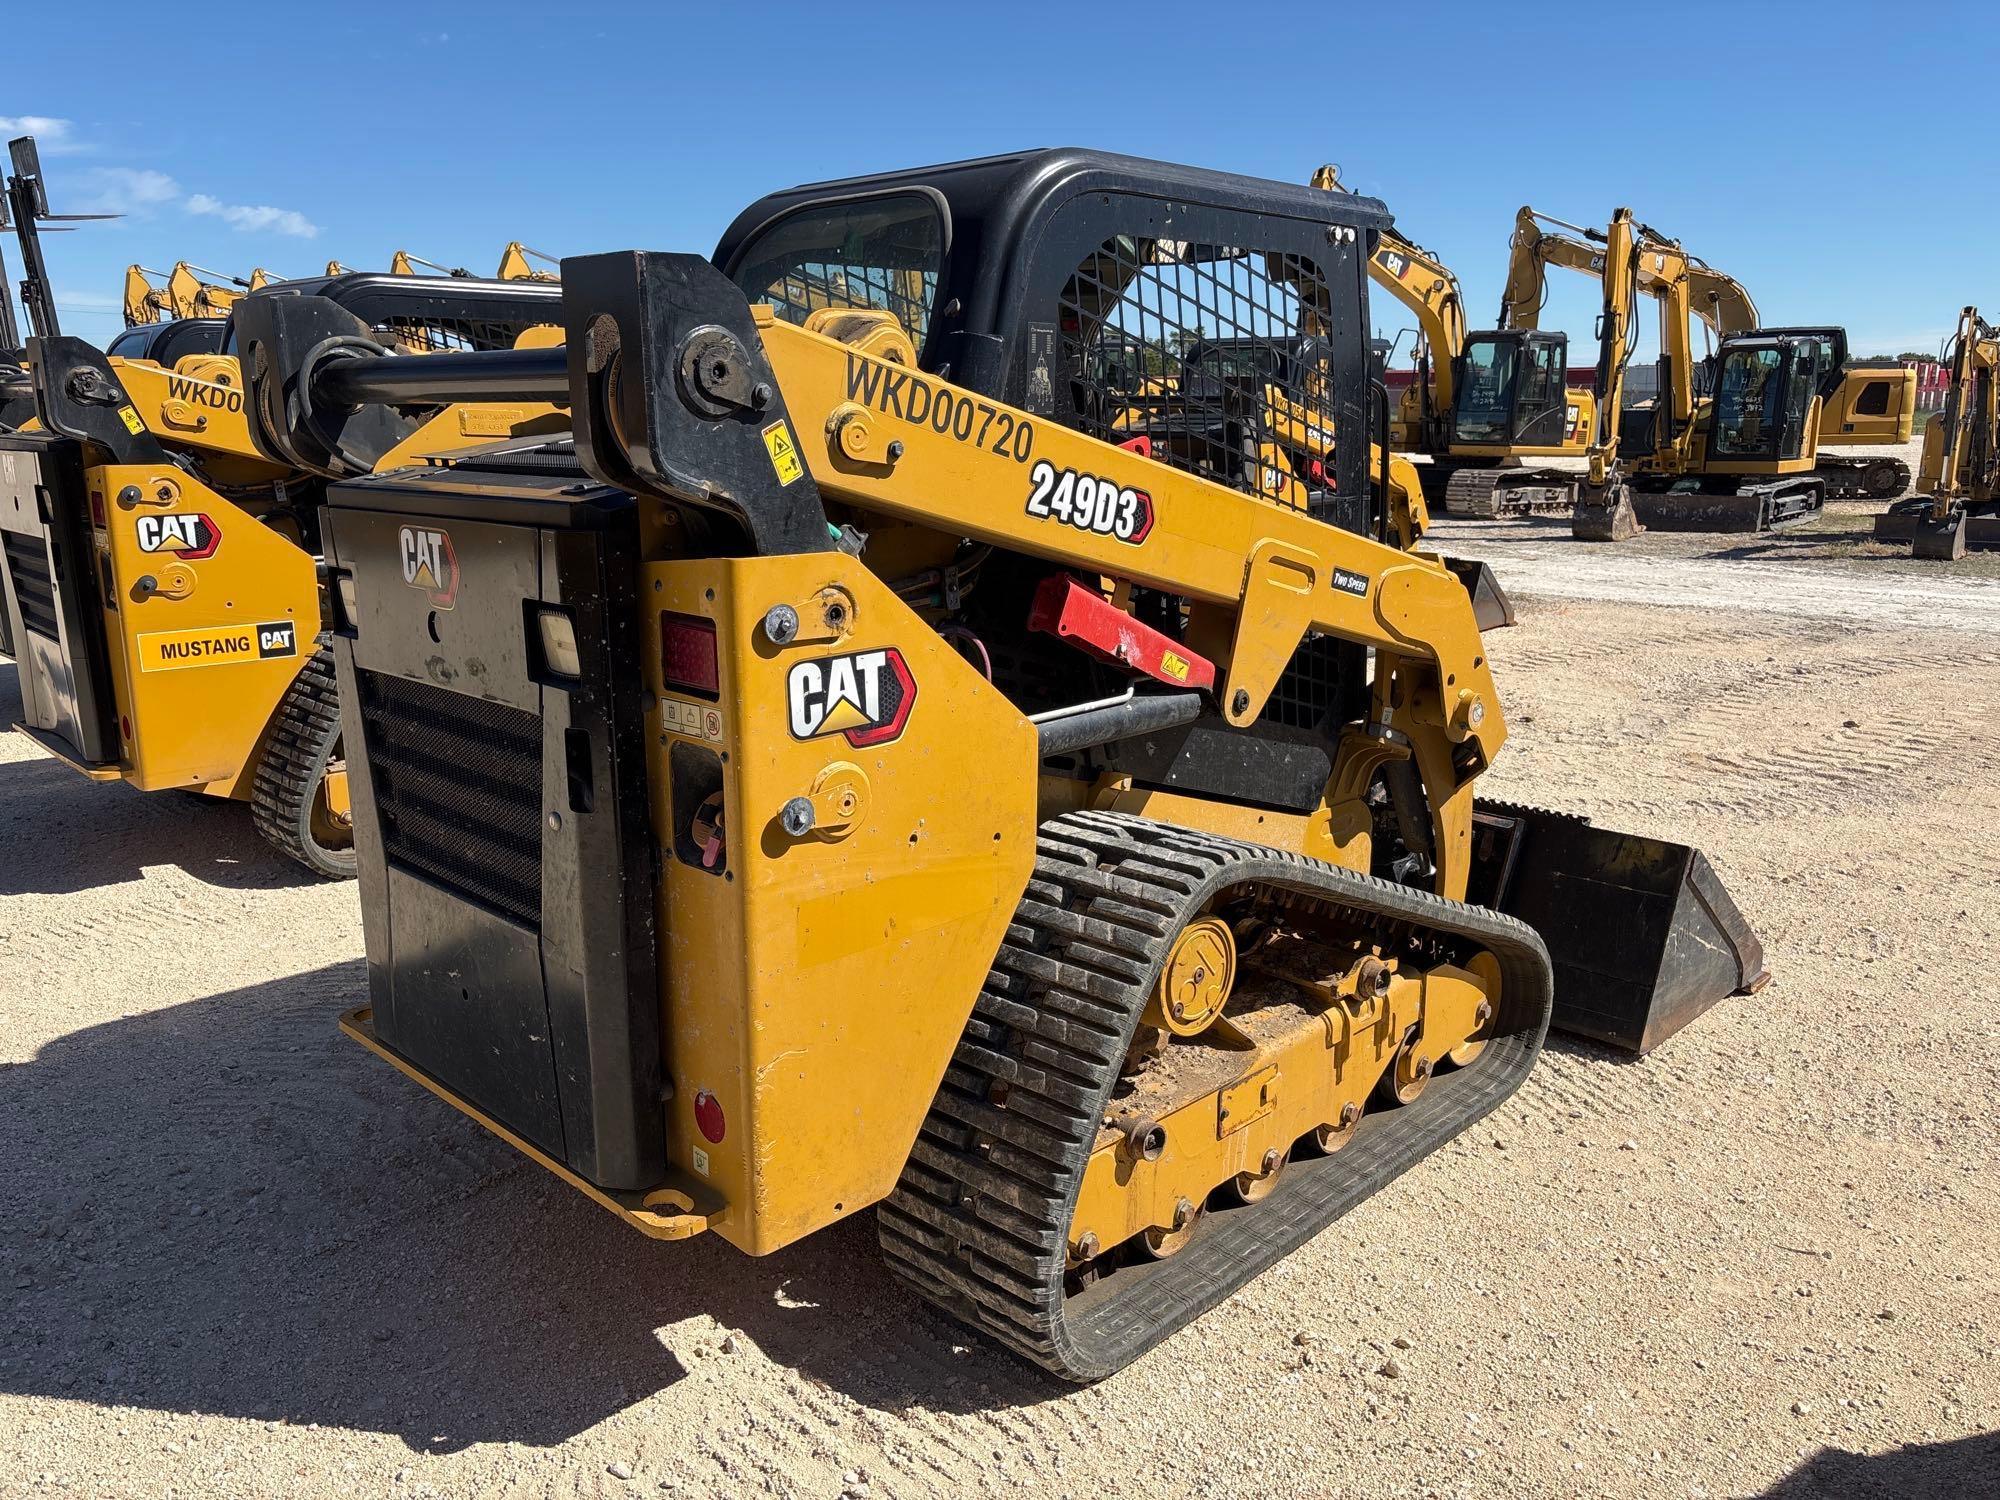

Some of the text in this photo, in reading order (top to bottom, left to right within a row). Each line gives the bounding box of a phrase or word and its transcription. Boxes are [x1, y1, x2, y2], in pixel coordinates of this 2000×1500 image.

[1386, 253, 1403, 277] CAT
[1590, 256, 1605, 270] CA
[168, 375, 242, 413] WKD0
[846, 352, 1034, 464] WKD00720
[1027, 461, 1137, 540] 249D3
[137, 514, 200, 552] CAT
[400, 528, 443, 589] CAT
[160, 630, 292, 660] MUSTANG CAT
[788, 650, 887, 738] CAT
